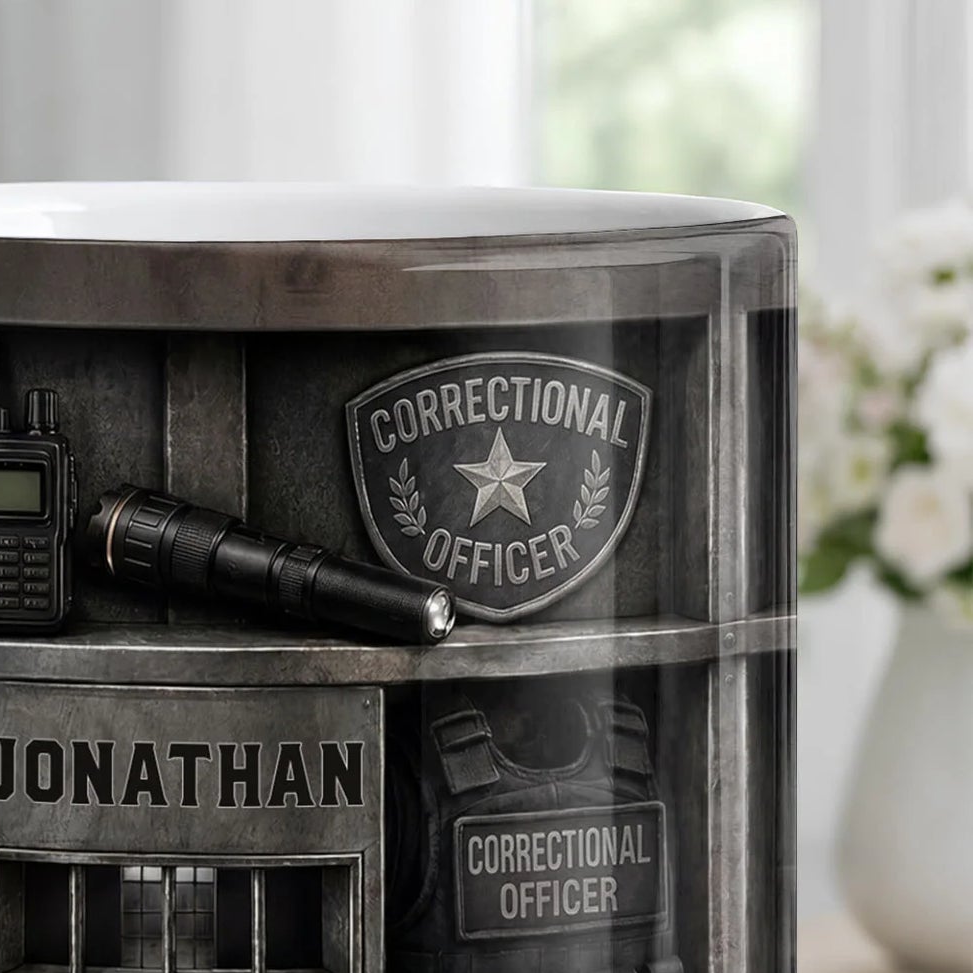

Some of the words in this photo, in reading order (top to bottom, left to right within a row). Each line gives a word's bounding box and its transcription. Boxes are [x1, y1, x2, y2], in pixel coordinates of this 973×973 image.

[370, 376, 627, 453] CORRECTIONAL
[423, 524, 580, 586] OFFICER
[467, 824, 651, 875] CORRECTIONAL
[500, 876, 618, 919] OFFICER
